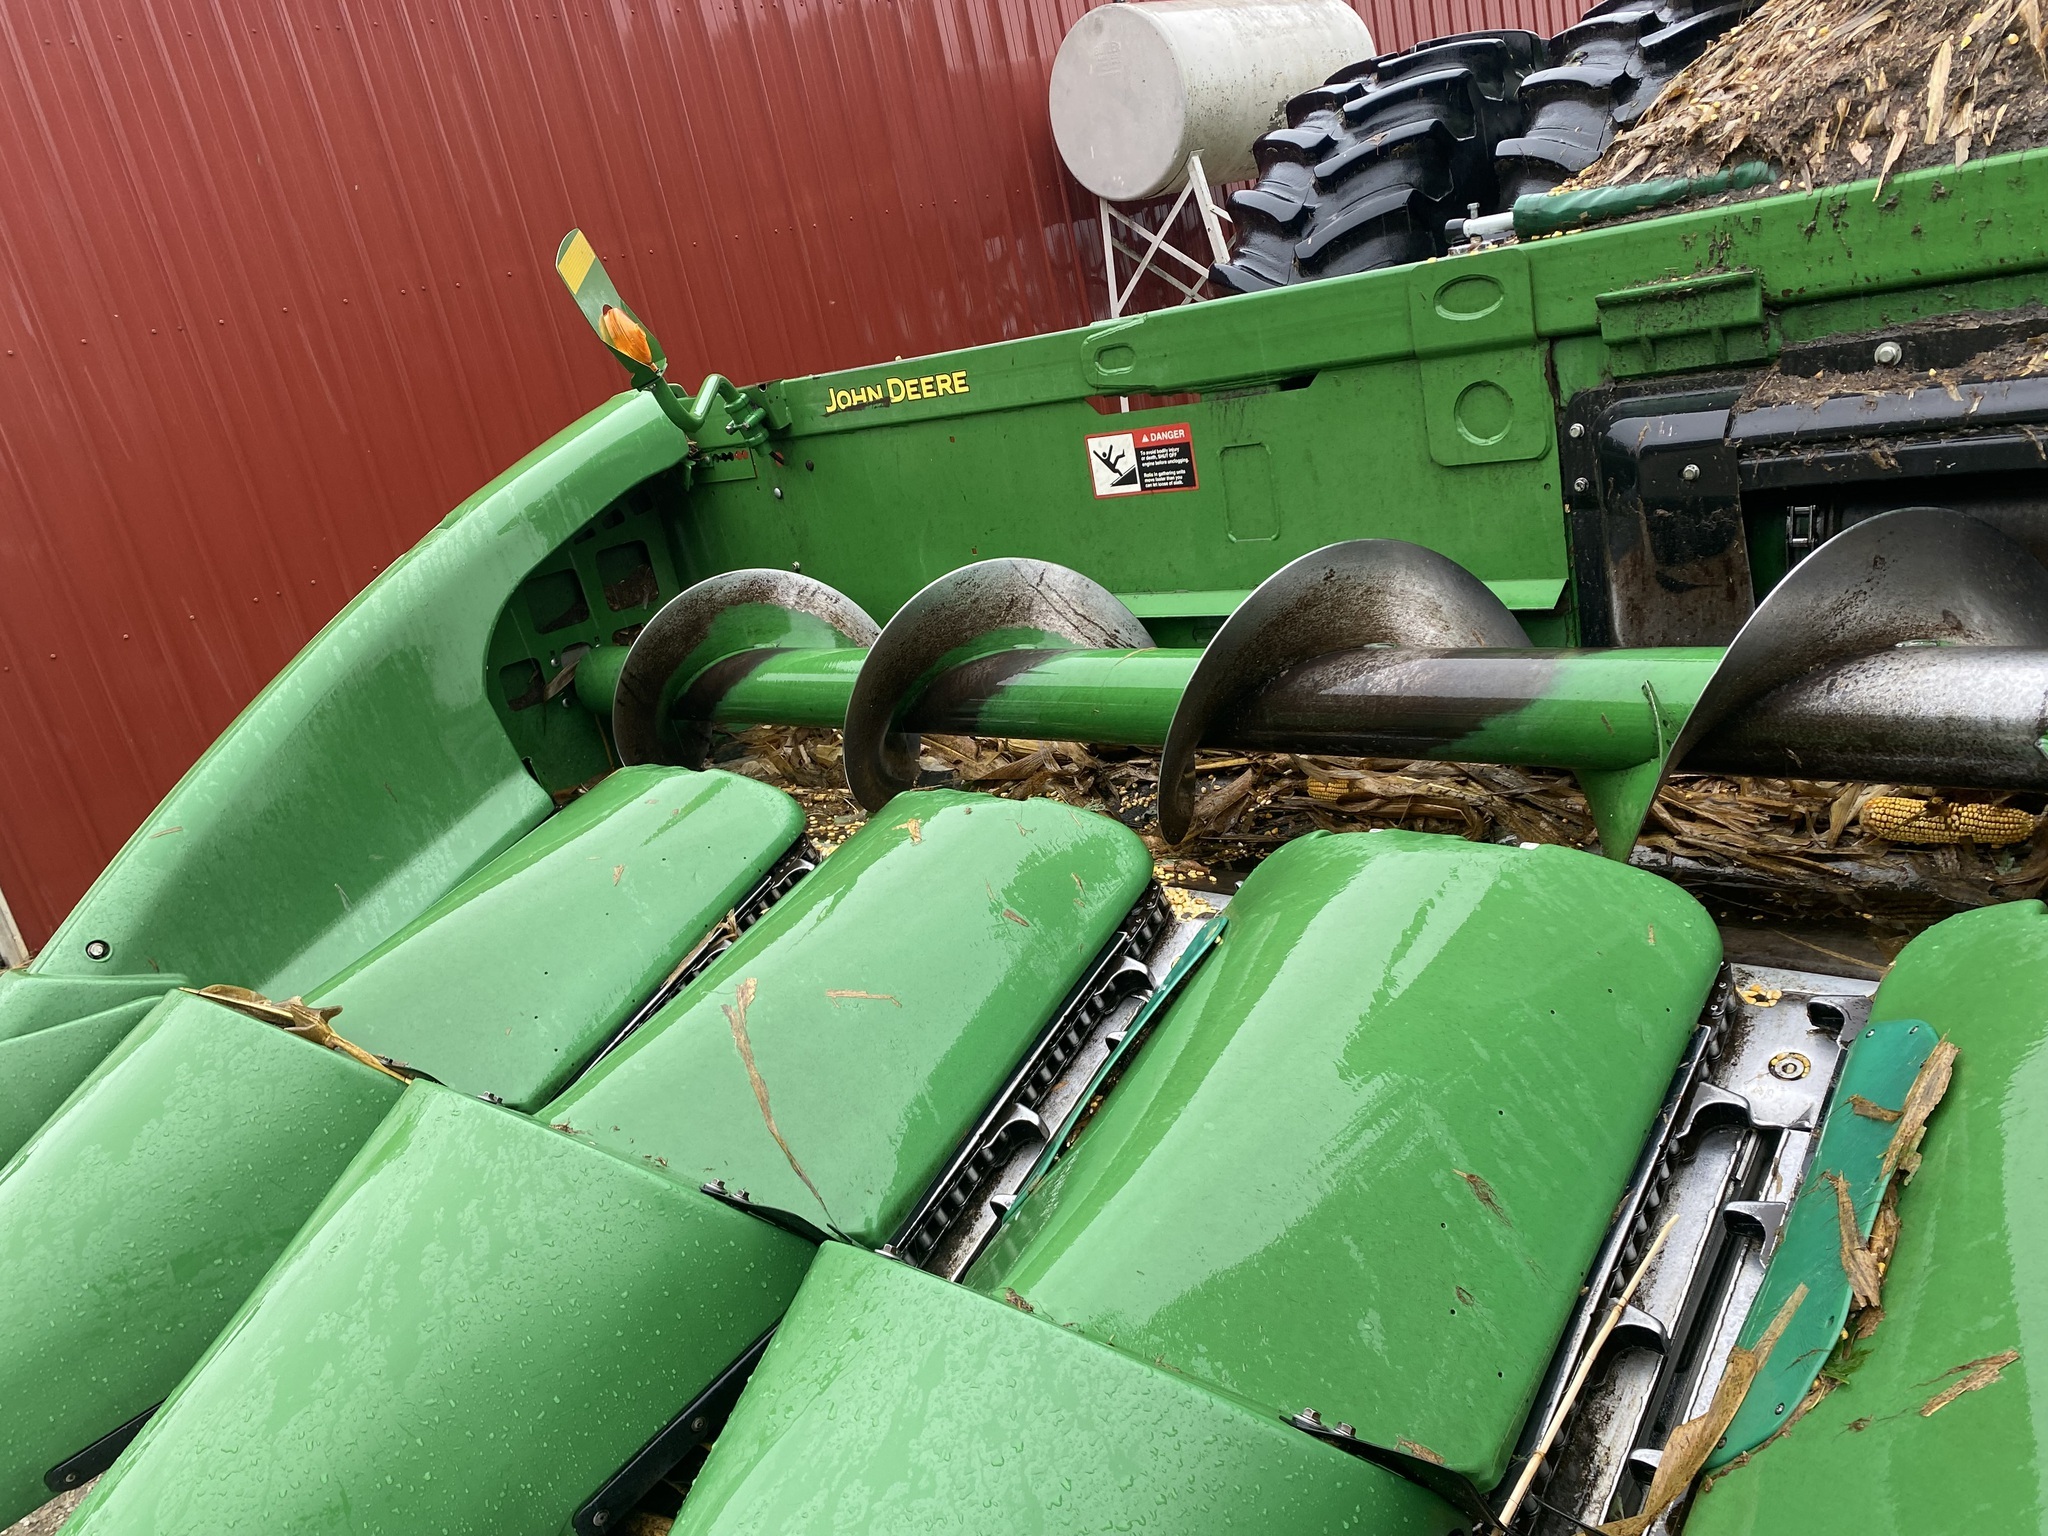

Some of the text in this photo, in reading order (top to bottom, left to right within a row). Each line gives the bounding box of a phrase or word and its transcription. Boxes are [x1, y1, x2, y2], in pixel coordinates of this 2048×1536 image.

[825, 370, 970, 413] JOHN DEERE
[1150, 429, 1185, 442] DANGER
